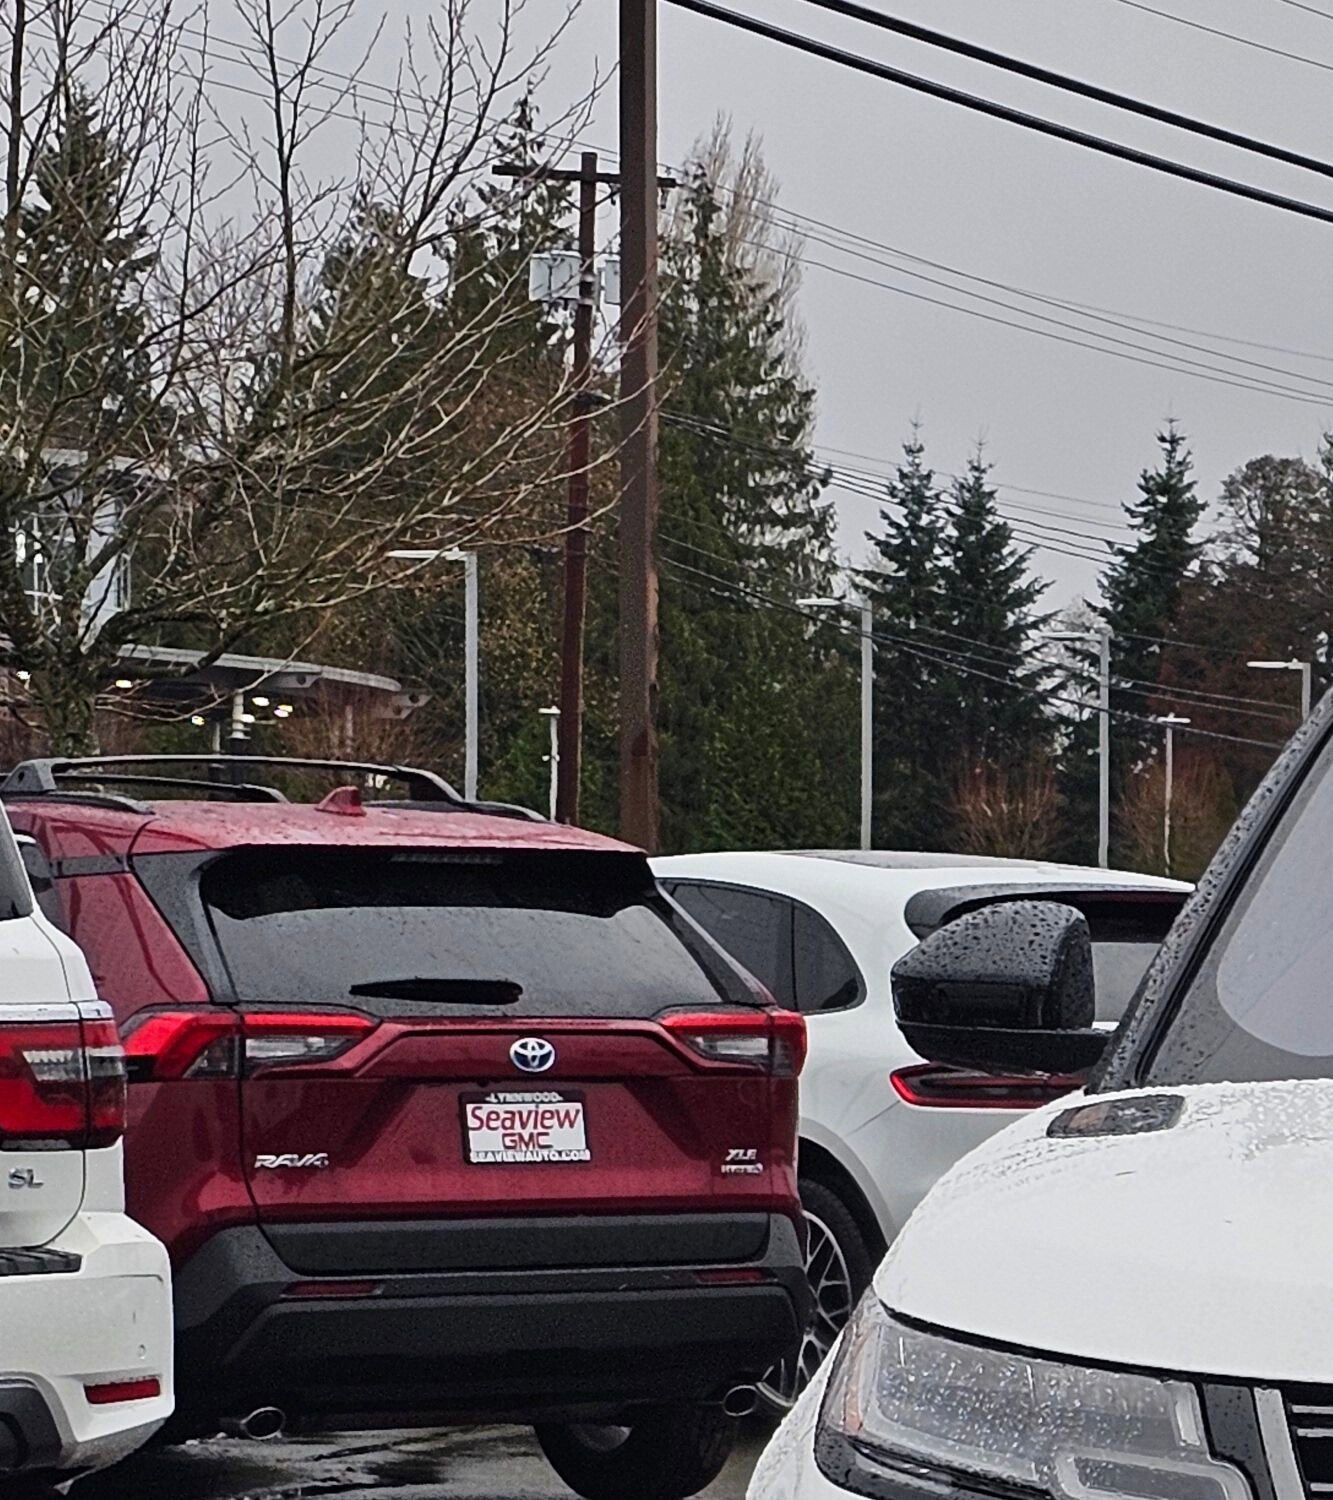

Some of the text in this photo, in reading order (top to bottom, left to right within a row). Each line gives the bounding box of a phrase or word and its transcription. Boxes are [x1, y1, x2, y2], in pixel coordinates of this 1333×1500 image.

[468, 1104, 581, 1131] Seaview
[502, 1132, 553, 1149] GMC
[254, 1152, 329, 1168] RAV4
[725, 1148, 758, 1161] XLE
[8, 1168, 44, 1190] SL
